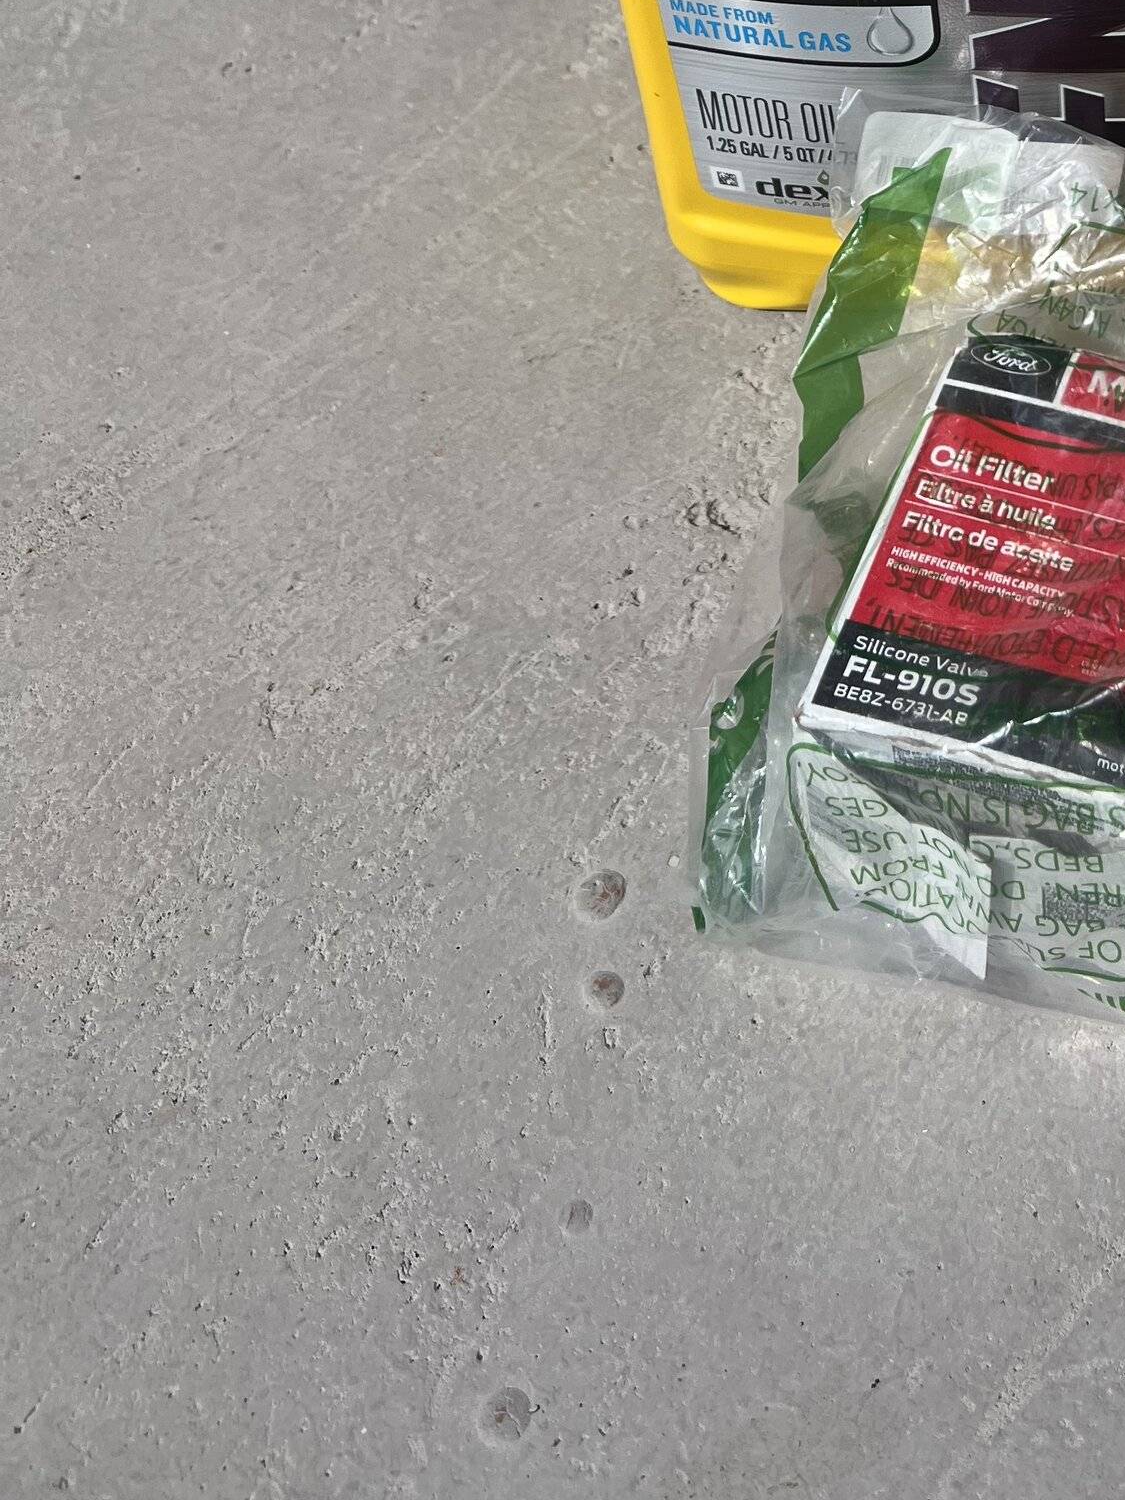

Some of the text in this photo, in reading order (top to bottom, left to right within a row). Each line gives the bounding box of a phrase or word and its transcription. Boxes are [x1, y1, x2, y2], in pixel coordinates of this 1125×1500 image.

[722, 6, 774, 26] FROM
[673, 15, 852, 53] NATURAL GAS
[695, 88, 794, 141] MOTOR
[706, 135, 737, 154] 1.25
[740, 140, 770, 159] GAL
[783, 146, 794, 161] 5
[797, 149, 815, 163] QT
[981, 344, 1039, 373] Ford
[929, 444, 973, 474] Oil
[974, 455, 1056, 494] Filter
[901, 510, 965, 543] Filtro
[968, 530, 999, 551] de
[890, 546, 918, 562] HIGH
[917, 552, 980, 577] EFFICIENCY
[983, 571, 1012, 586] HIGH
[1011, 578, 1065, 599] CAPACITY
[958, 574, 972, 590] by
[972, 579, 996, 598] Ford
[853, 635, 989, 678] Silicone Valve
[842, 654, 982, 708] FL-910S
[982, 797, 1011, 828] IS
[1021, 802, 1096, 836] BAG
[841, 828, 908, 853] USE
[917, 828, 972, 879] NOT
[849, 853, 948, 887] FROM
[975, 874, 1026, 901] DO
[1034, 912, 1106, 937] BAG
[1077, 937, 1122, 963] OF
